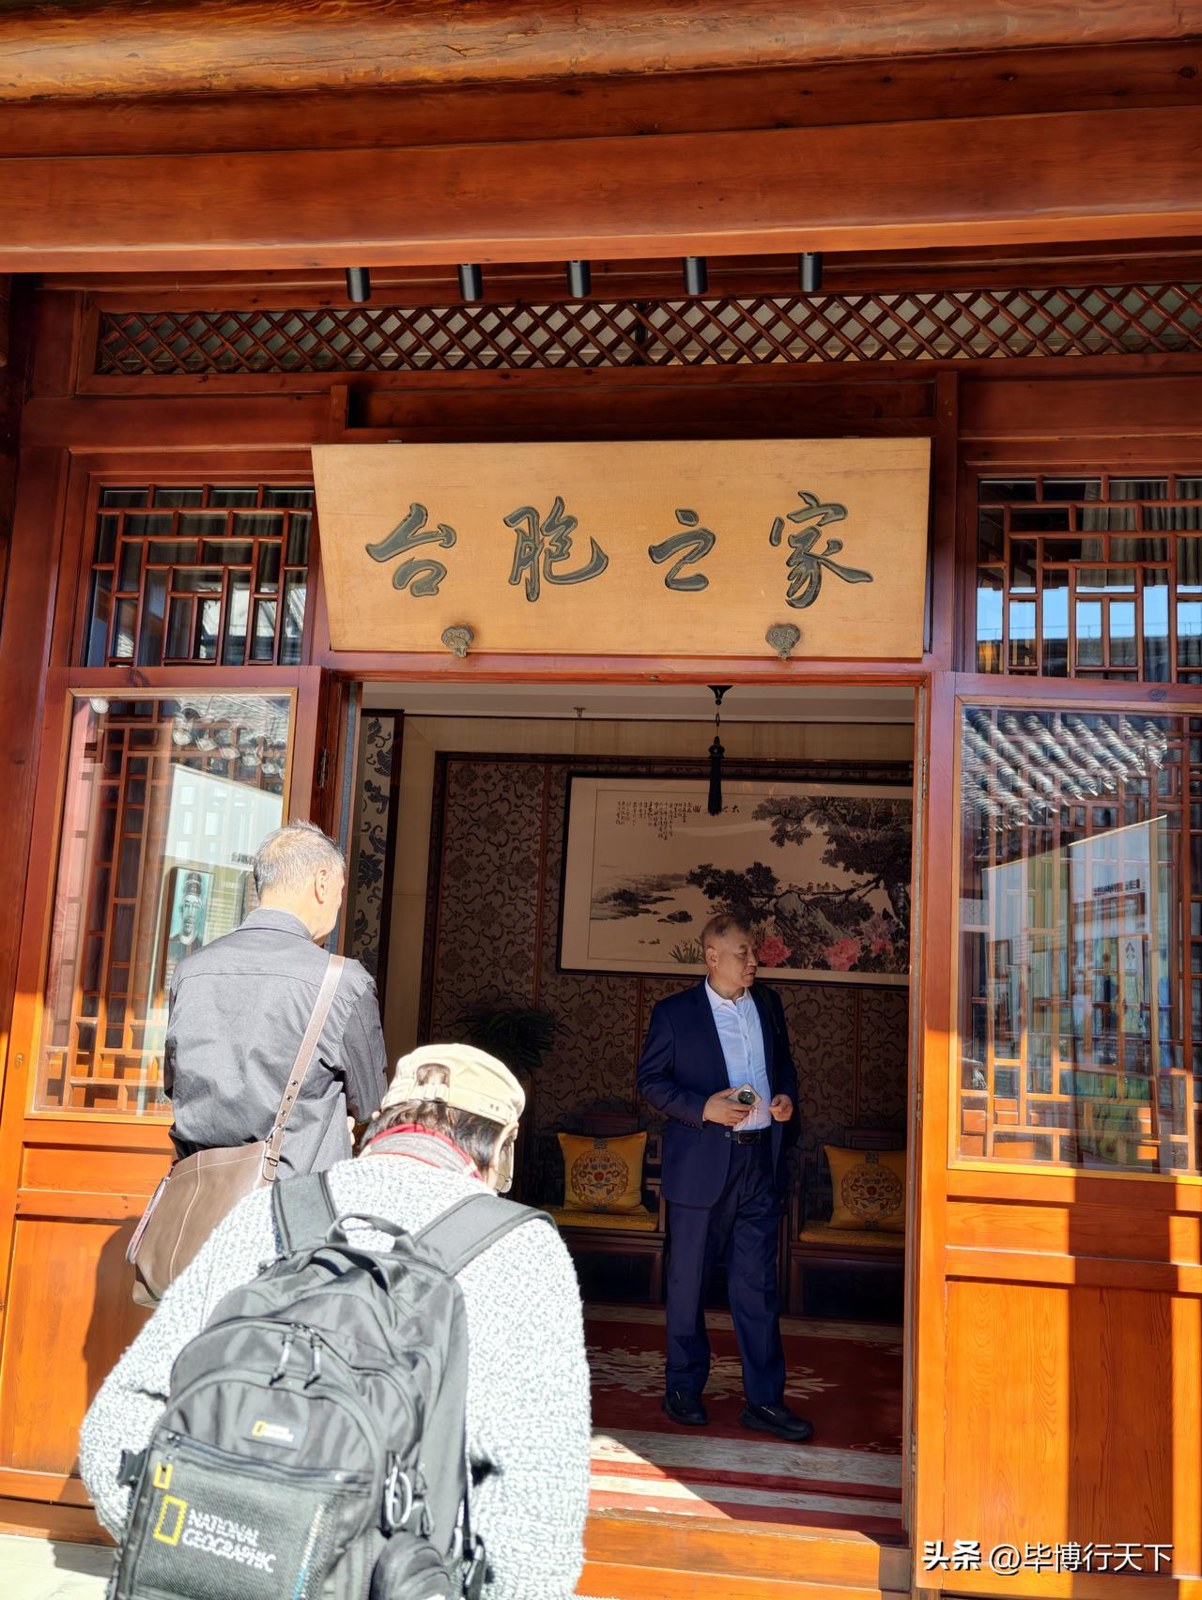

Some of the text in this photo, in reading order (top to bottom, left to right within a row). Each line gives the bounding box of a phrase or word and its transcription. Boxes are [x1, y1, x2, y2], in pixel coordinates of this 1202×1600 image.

[366, 490, 874, 609] 台胞之家
[187, 1508, 260, 1547] NATIONAL
[182, 1529, 277, 1573] GEOGRAPHIC
